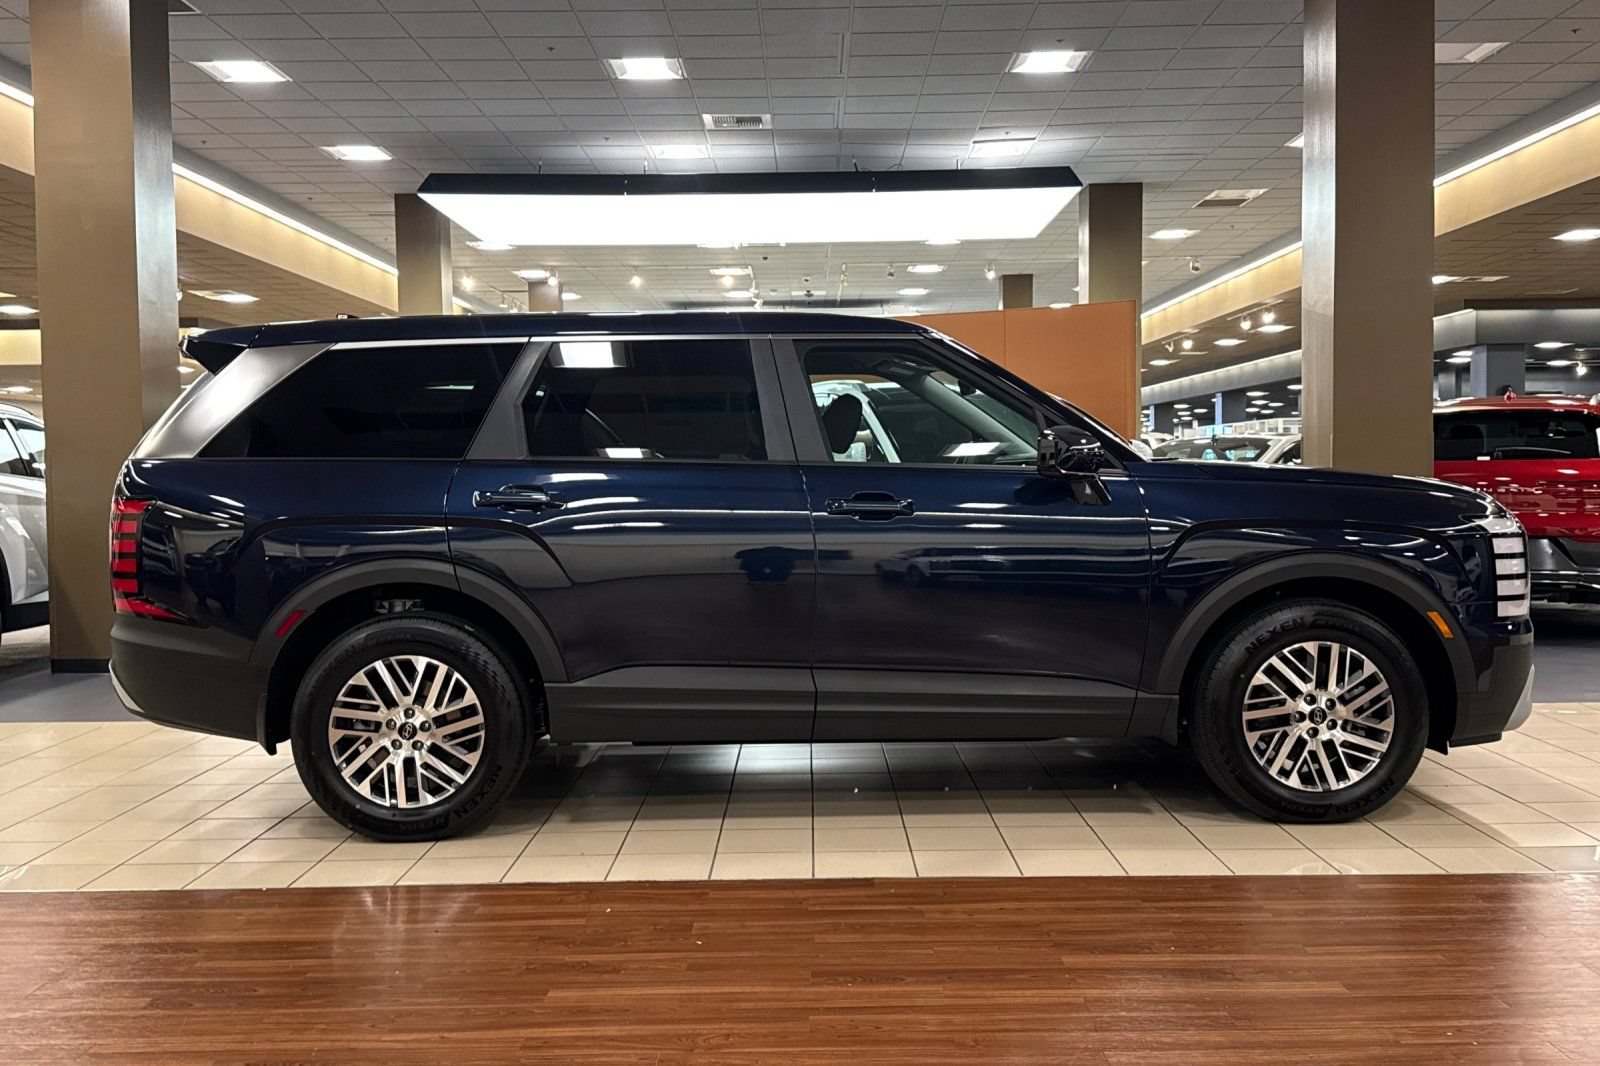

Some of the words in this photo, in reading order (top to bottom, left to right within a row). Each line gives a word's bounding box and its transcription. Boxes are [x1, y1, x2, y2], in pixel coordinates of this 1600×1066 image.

[1246, 617, 1304, 656] NEXEN
[454, 765, 502, 818] NEXEN
[1337, 780, 1395, 816] NEXEN
